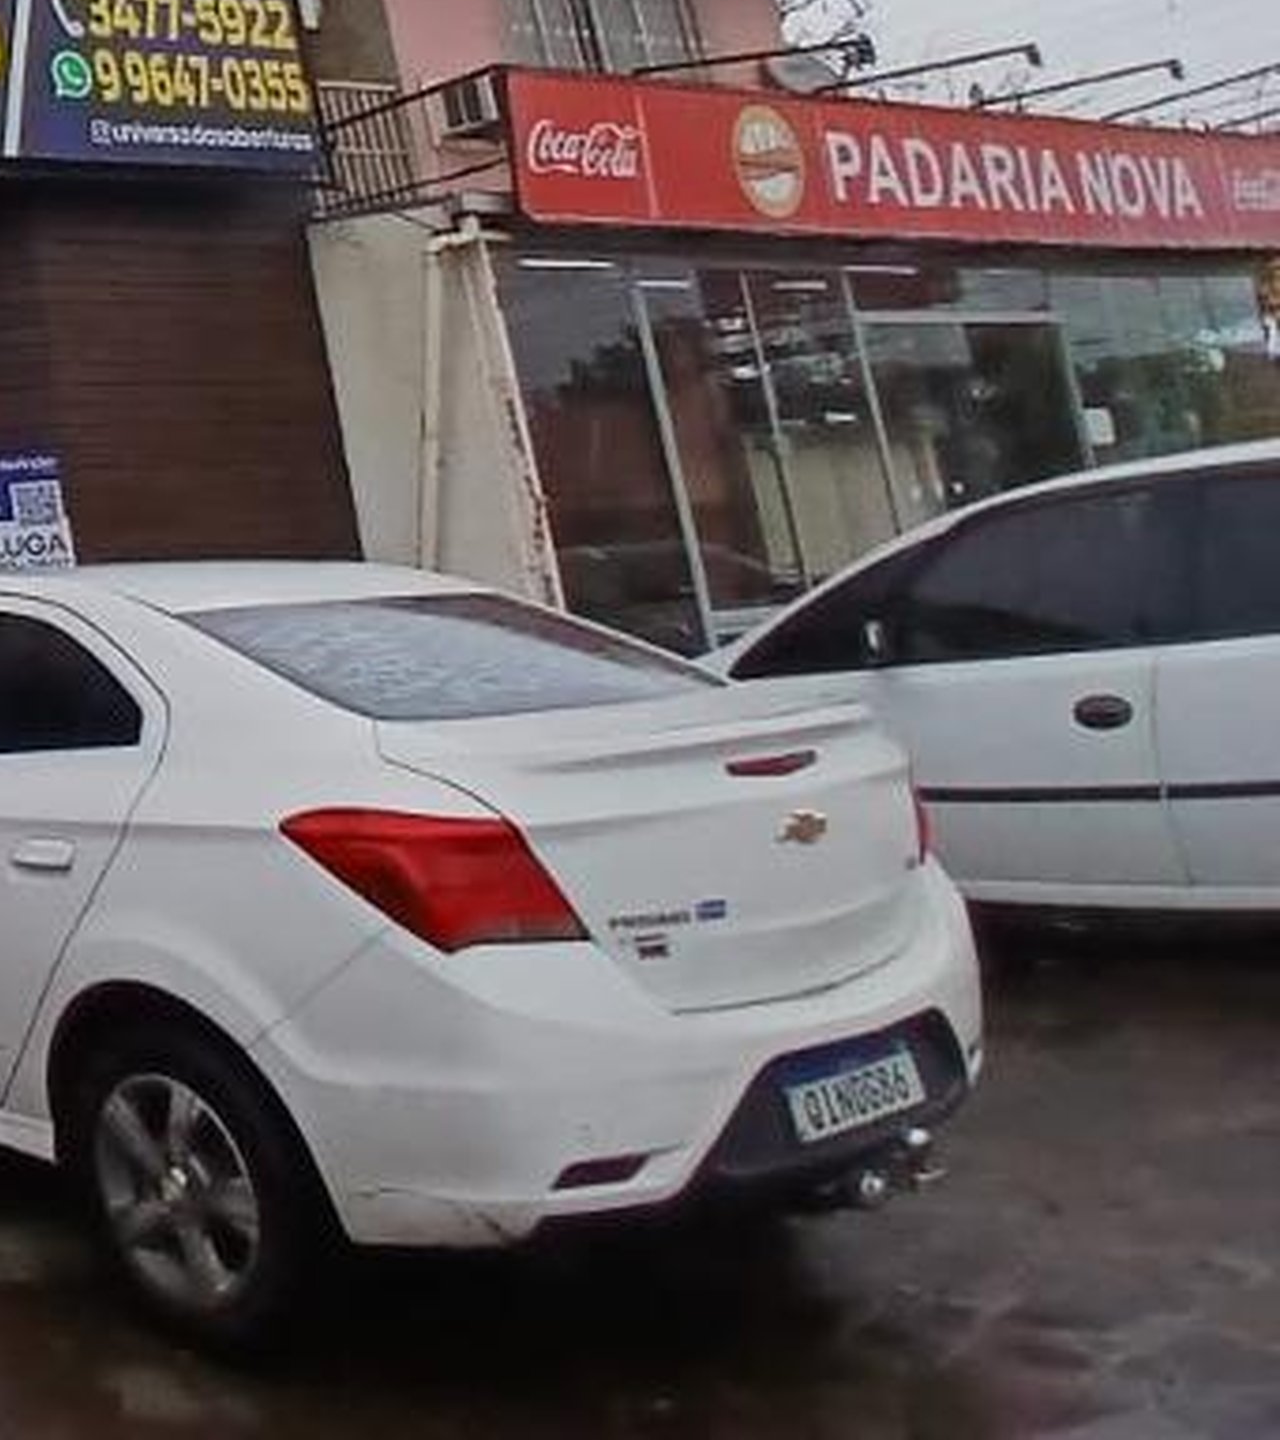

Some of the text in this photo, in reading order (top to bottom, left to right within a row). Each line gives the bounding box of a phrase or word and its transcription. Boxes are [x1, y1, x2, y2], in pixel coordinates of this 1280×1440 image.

[528, 119, 645, 177] Coca-Cola
[824, 130, 1076, 213] PADARIA
[1076, 151, 1204, 219] NOVA
